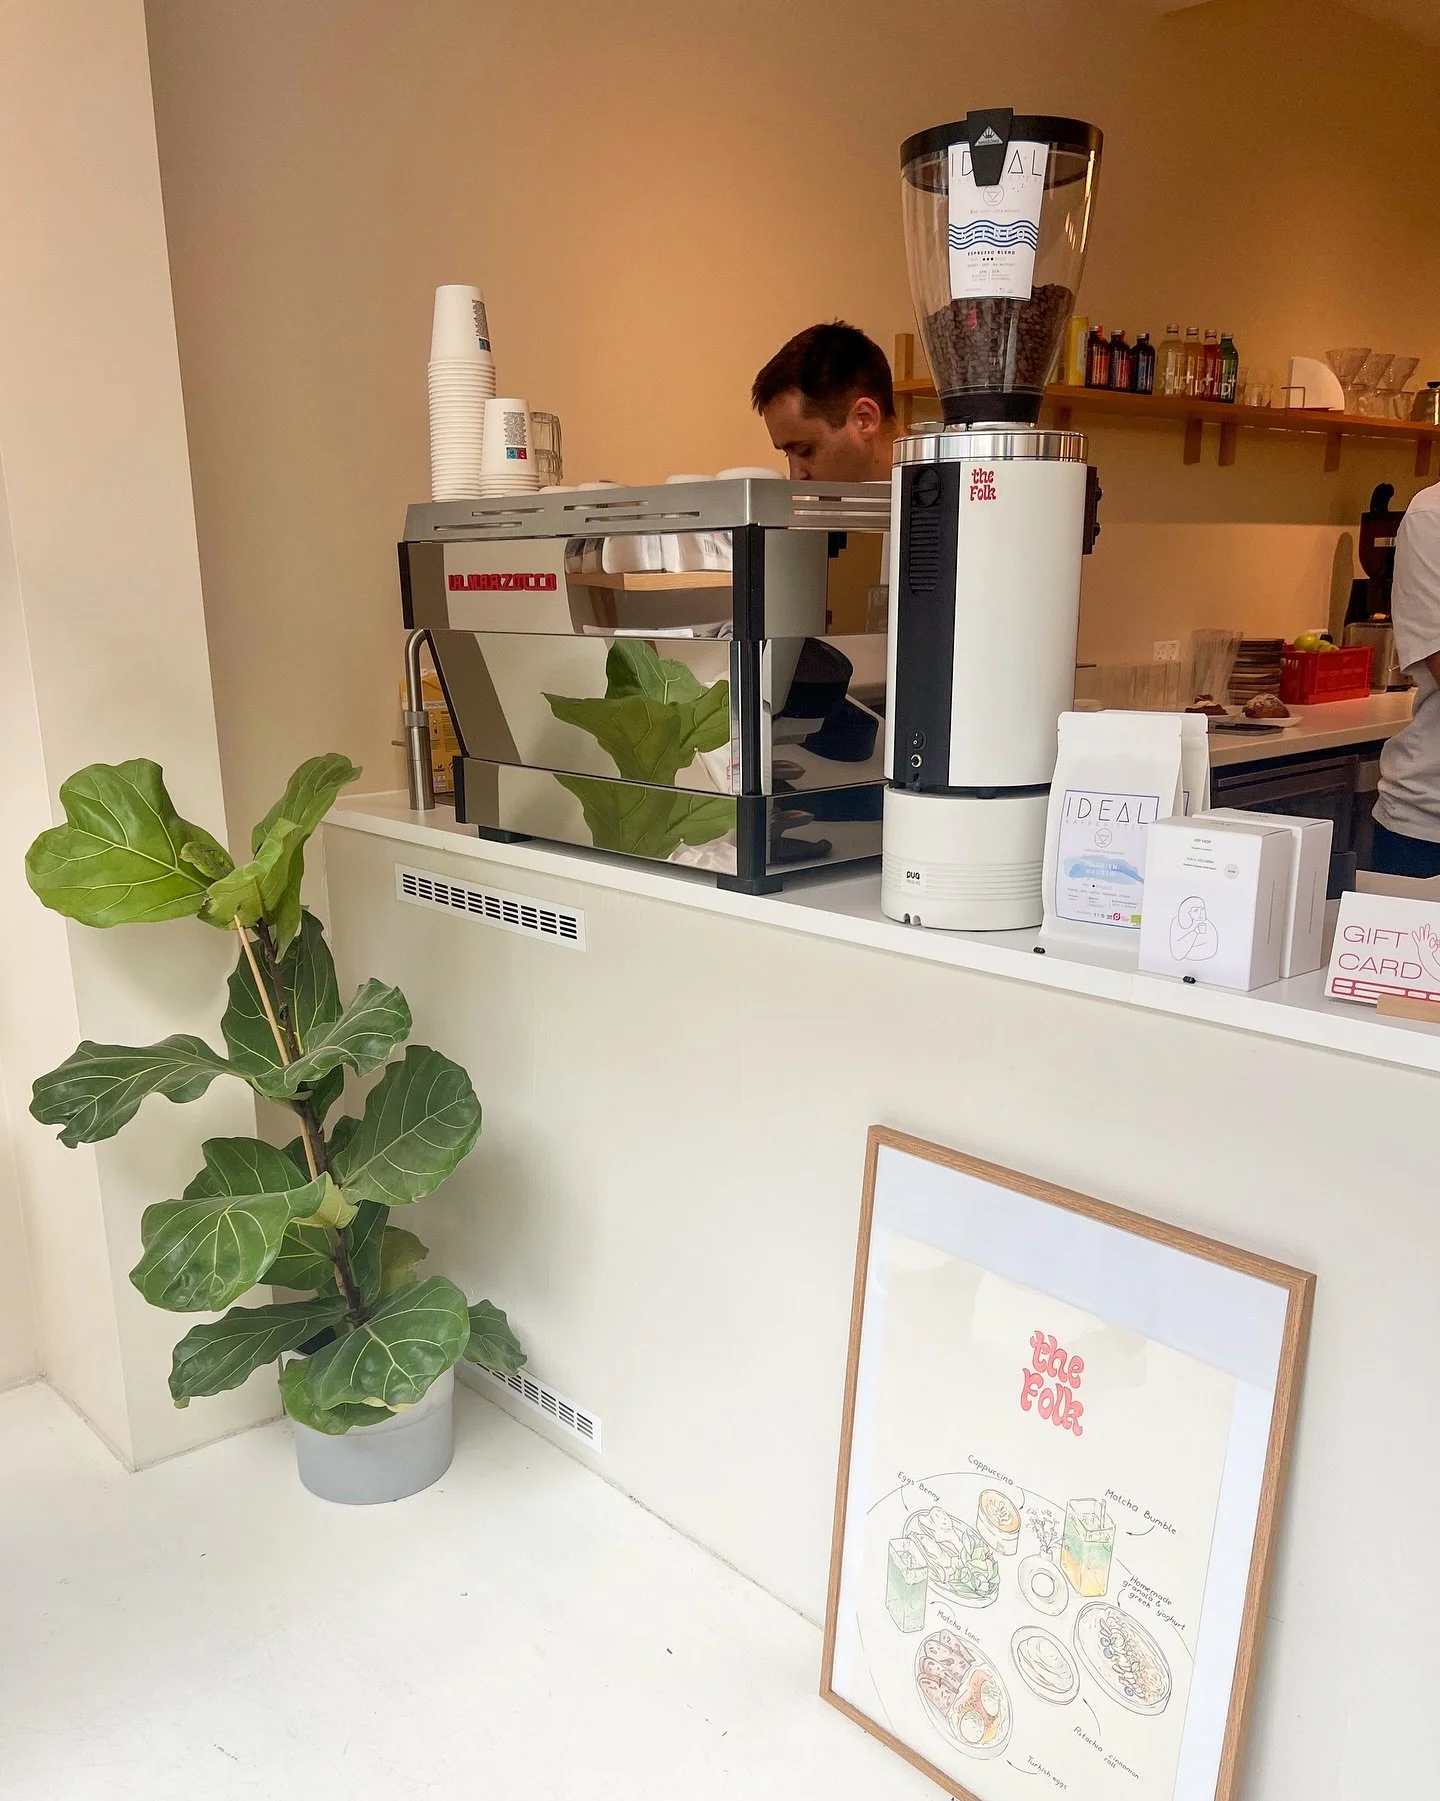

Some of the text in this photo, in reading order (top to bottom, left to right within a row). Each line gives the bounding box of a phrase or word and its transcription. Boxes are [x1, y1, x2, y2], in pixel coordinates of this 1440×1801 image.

[951, 149, 1042, 178] IDAL
[971, 467, 994, 484] the
[970, 484, 997, 501] Folk
[1065, 796, 1150, 825] IDEAL
[1343, 925, 1409, 949] GIFT
[1338, 953, 1423, 980] CARD
[1029, 1330, 1085, 1389] the
[1020, 1367, 1084, 1436] Folk
[967, 1454, 1014, 1486] Cappuccino
[896, 1470, 941, 1502] Eggs Benny
[1104, 1488, 1177, 1535] Matcha Bumble
[1122, 1580, 1154, 1603] granola
[1130, 1574, 1173, 1606] Homemade
[936, 1610, 962, 1631] Matcha
[1155, 1609, 1187, 1632] yoghurt
[1073, 1725, 1140, 1780] Pistachio cinnamon
[1102, 1757, 1117, 1769] roll
[1026, 1755, 1069, 1791] Turkish eggs
